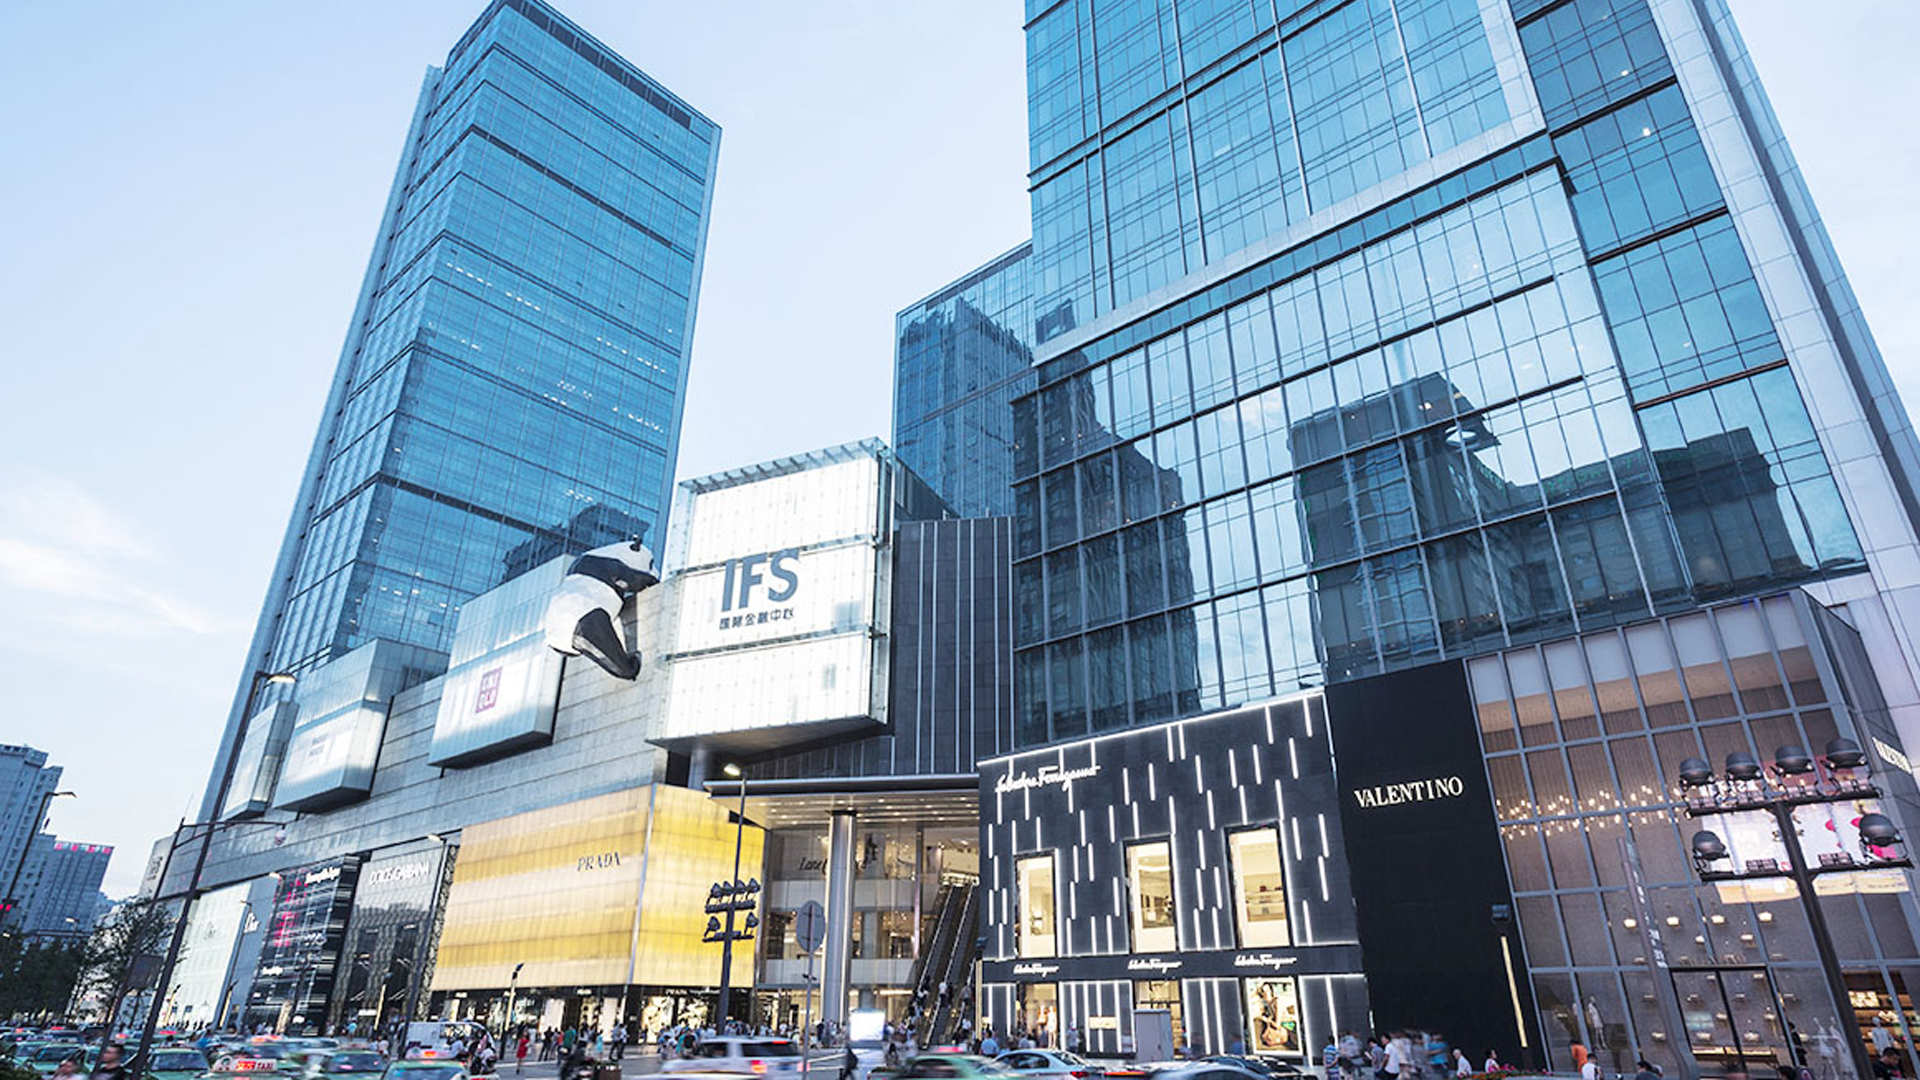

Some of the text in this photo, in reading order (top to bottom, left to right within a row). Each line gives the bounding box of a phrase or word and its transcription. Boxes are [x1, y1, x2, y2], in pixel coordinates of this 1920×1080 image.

[721, 547, 800, 612] IFS
[1354, 776, 1464, 808] VALENTINO
[577, 852, 621, 872] PRADA
